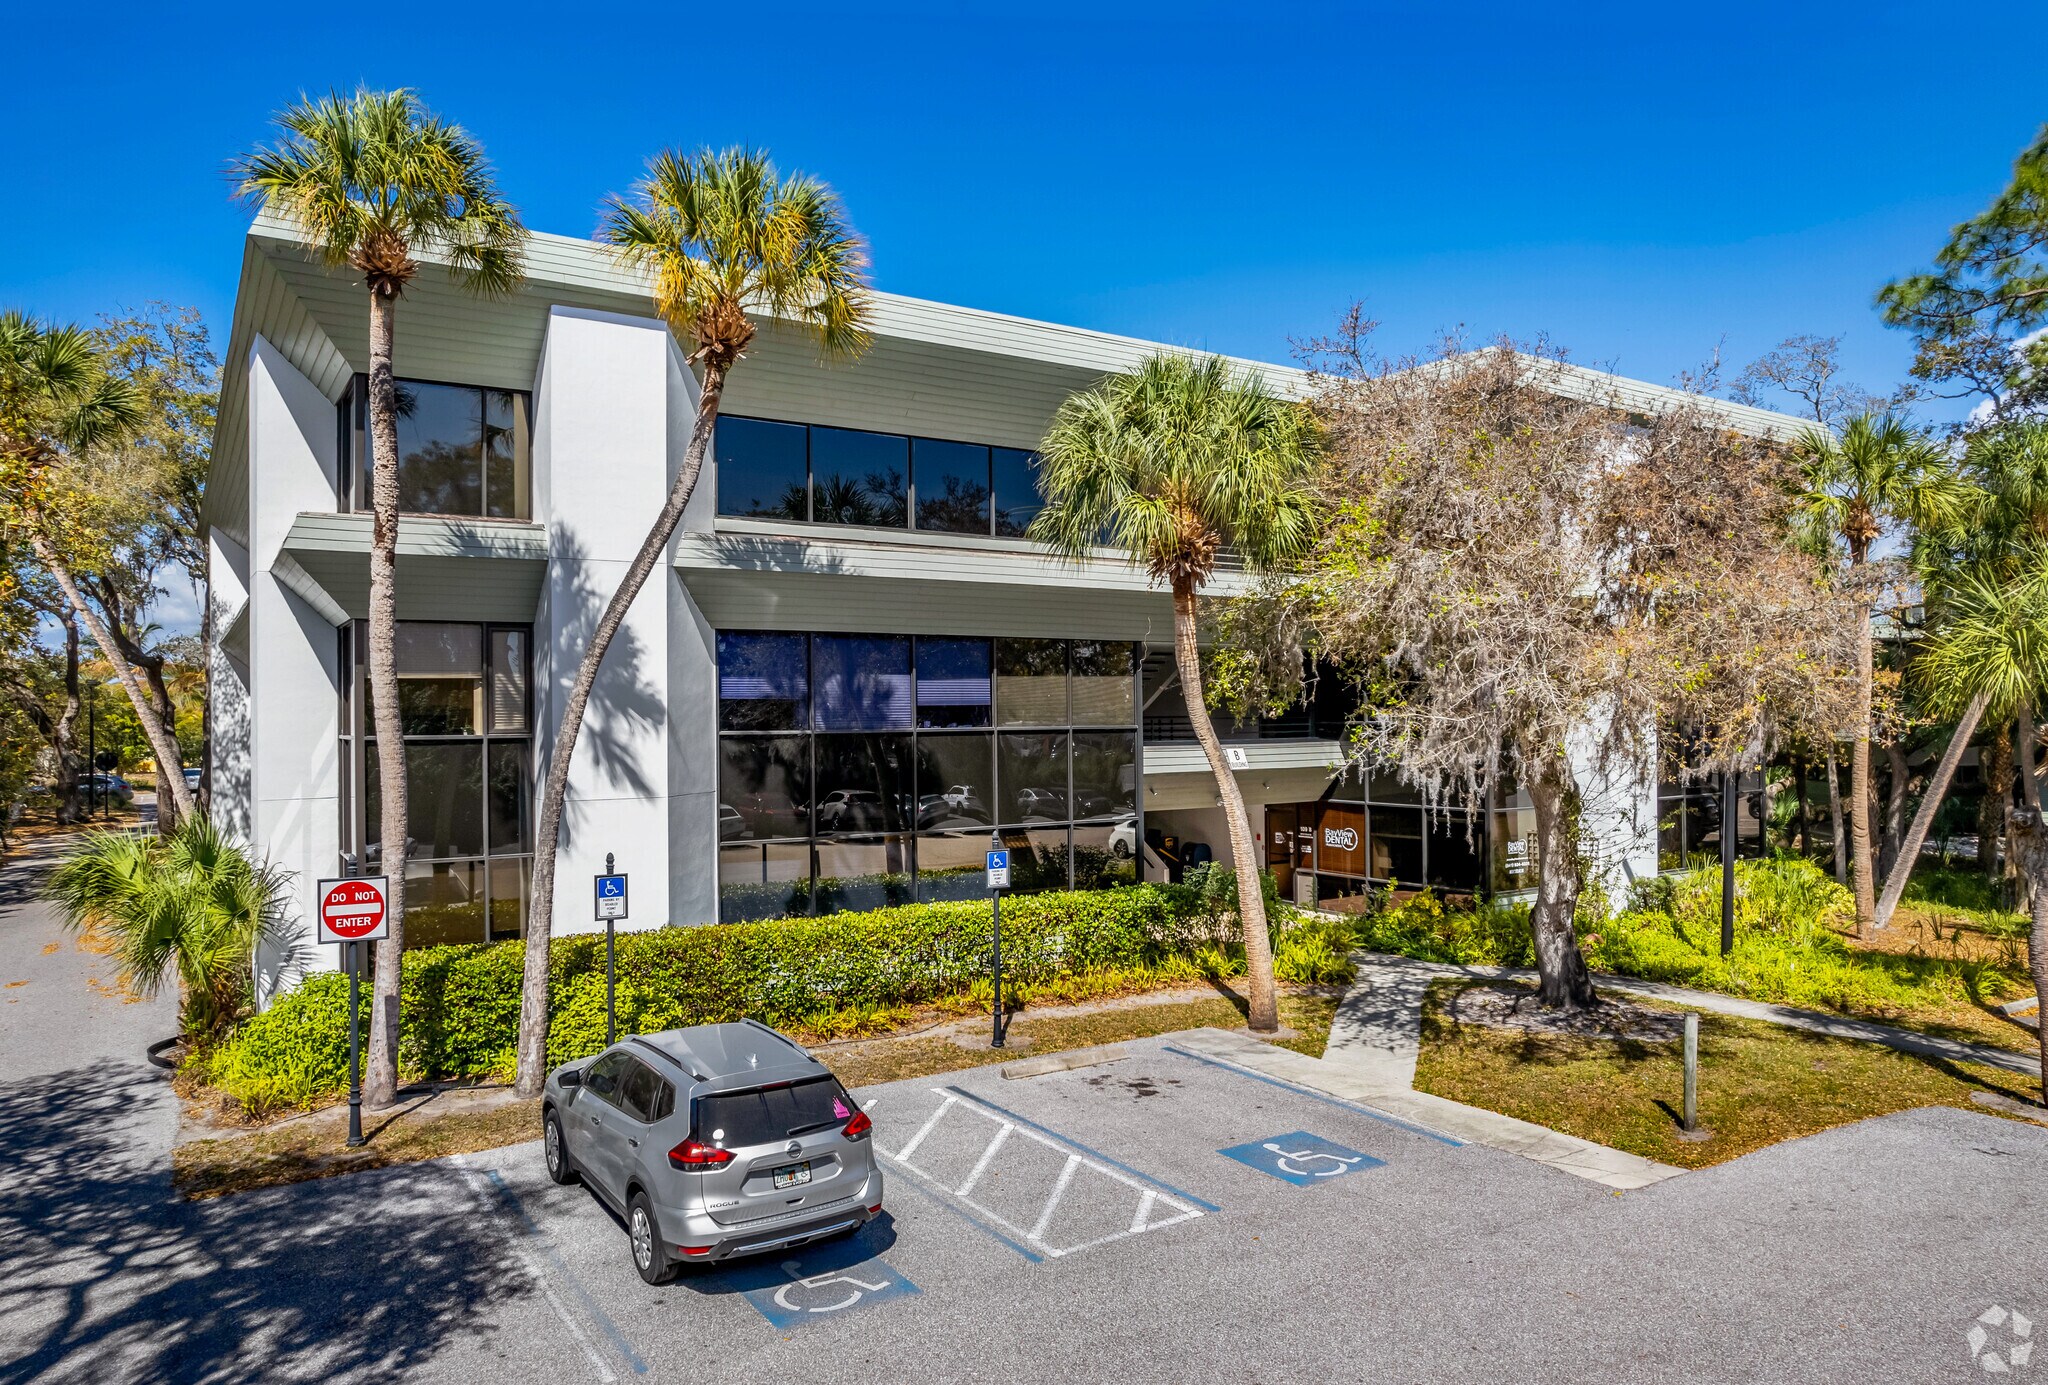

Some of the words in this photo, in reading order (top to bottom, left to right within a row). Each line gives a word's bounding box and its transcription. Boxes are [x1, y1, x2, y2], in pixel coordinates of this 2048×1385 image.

[1234, 750, 1241, 761] B
[1325, 827, 1353, 838] BayView
[1325, 835, 1354, 846] DENTAL
[331, 892, 347, 903] DO
[355, 891, 376, 901] NOT
[335, 916, 371, 928] ENTER
[710, 1200, 740, 1209] ROGUE
